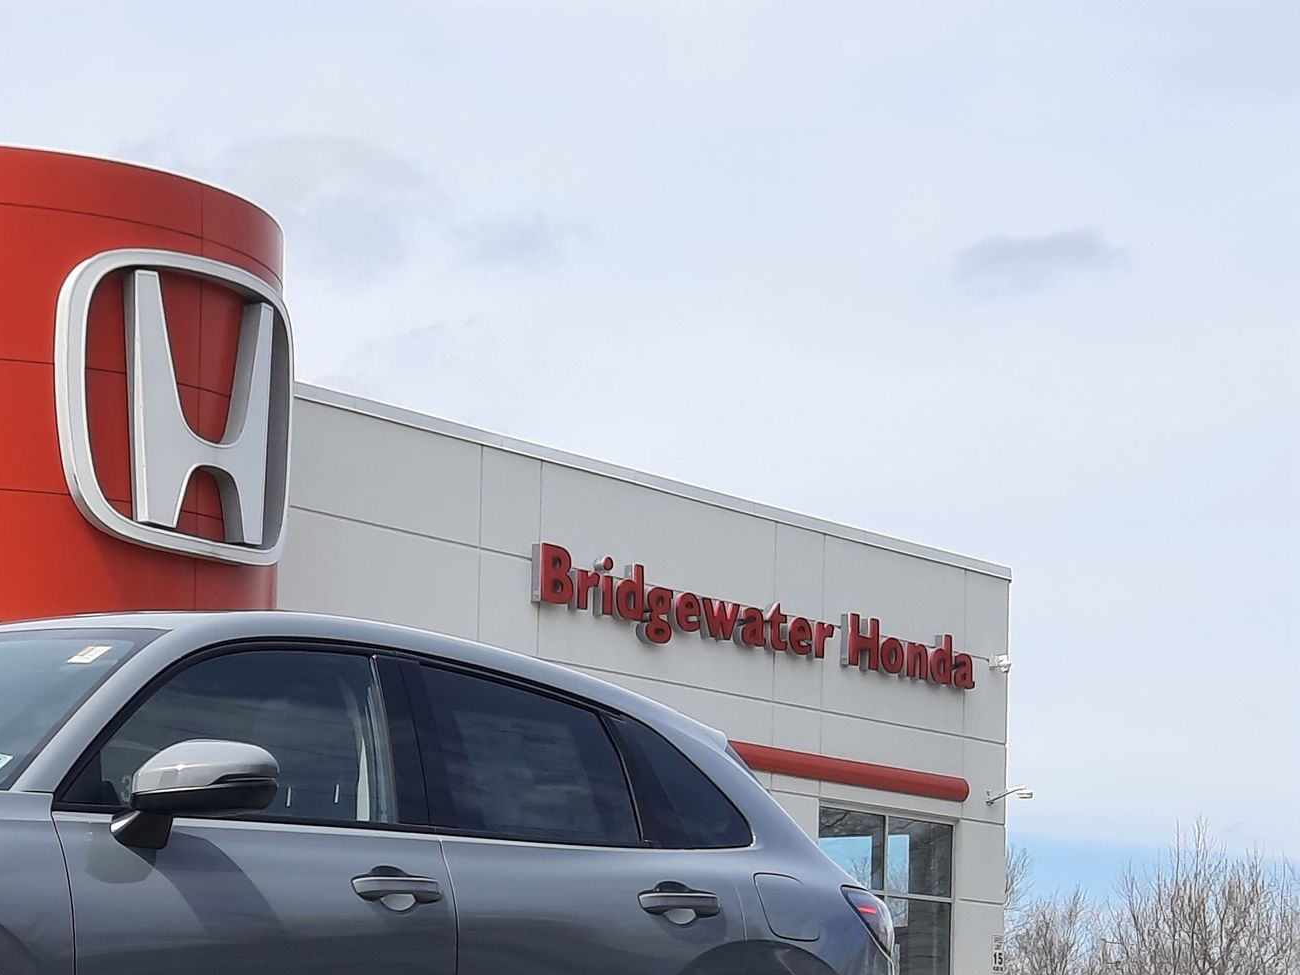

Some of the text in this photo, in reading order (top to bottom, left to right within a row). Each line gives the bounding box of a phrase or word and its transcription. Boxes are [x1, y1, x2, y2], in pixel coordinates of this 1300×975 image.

[536, 541, 976, 690] Bridgewater Honda
[993, 951, 1003, 965] 15
